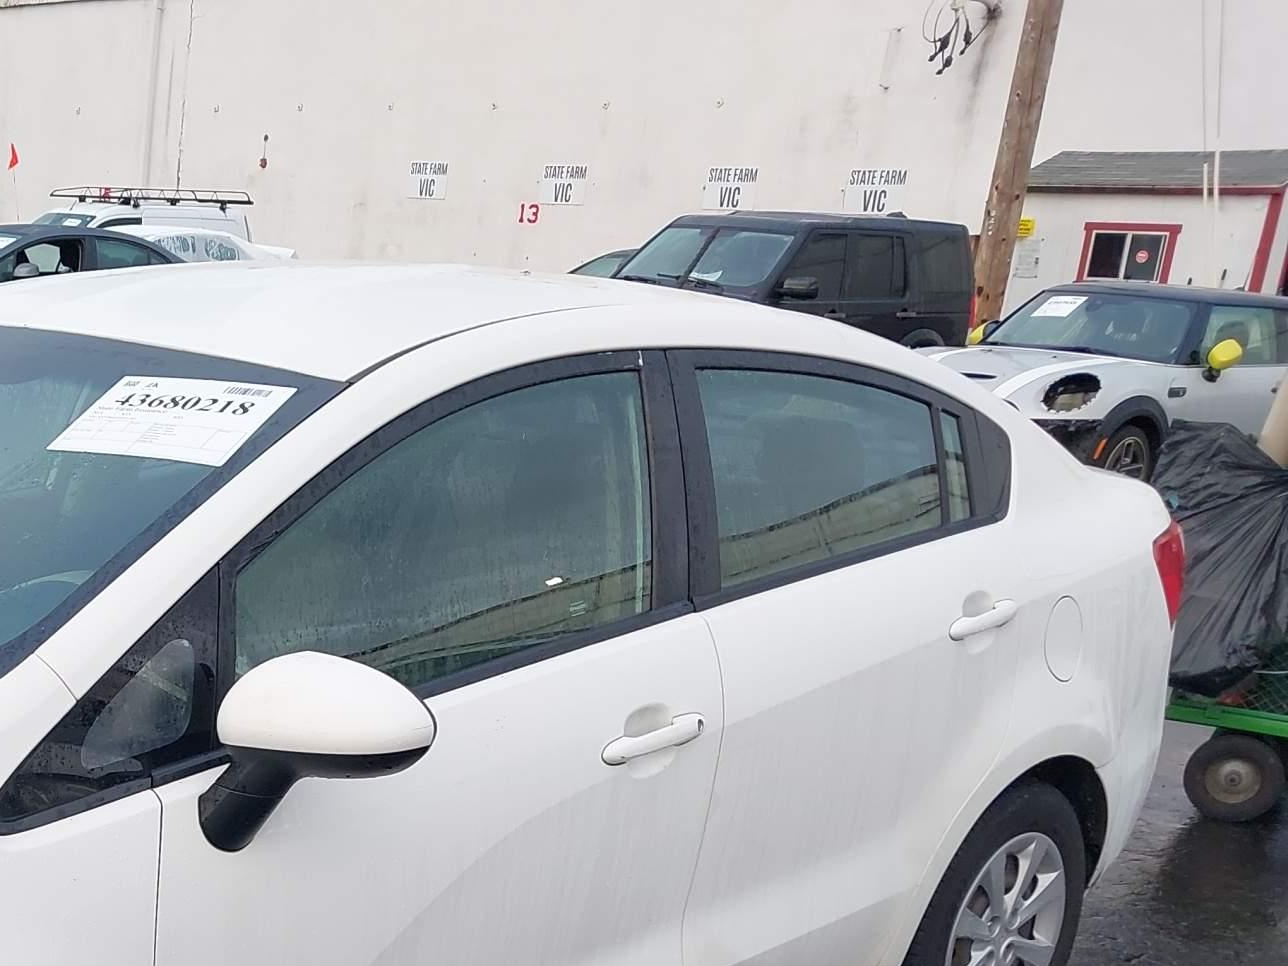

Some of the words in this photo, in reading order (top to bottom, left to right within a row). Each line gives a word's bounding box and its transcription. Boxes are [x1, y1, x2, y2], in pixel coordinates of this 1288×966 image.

[410, 162, 428, 176] STATE
[429, 162, 449, 176] FARM
[543, 165, 564, 179] STATE
[565, 165, 588, 180] FARM
[708, 167, 732, 183] STATE
[733, 167, 759, 183] FARM
[849, 169, 877, 185] STATE
[878, 169, 908, 186] FARM
[418, 178, 436, 198] VIC
[553, 182, 573, 203] VIC
[718, 186, 741, 208] VIC
[862, 189, 887, 213] VIC
[518, 203, 540, 224] 13
[115, 393, 256, 416] 43680218
